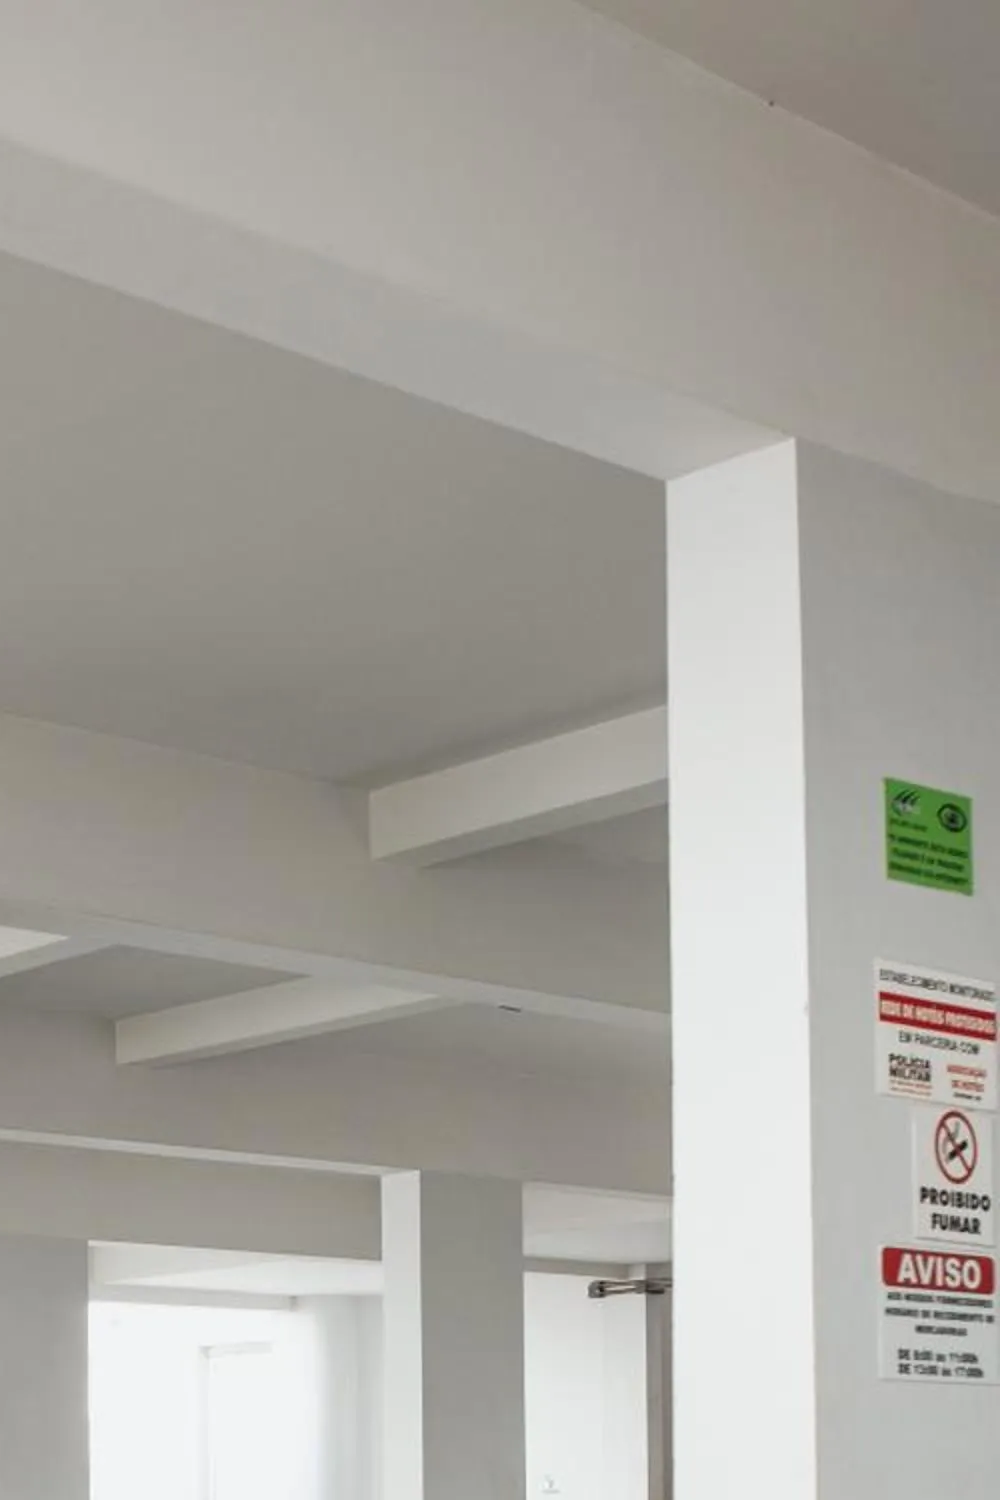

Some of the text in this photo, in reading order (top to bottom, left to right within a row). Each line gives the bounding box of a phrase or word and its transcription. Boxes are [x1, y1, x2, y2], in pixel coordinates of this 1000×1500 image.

[889, 1067, 931, 1082] MILITAR
[919, 1186, 991, 1212] PROIBIDO
[931, 1213, 981, 1235] FUMAR
[897, 1253, 982, 1289] AVISO
